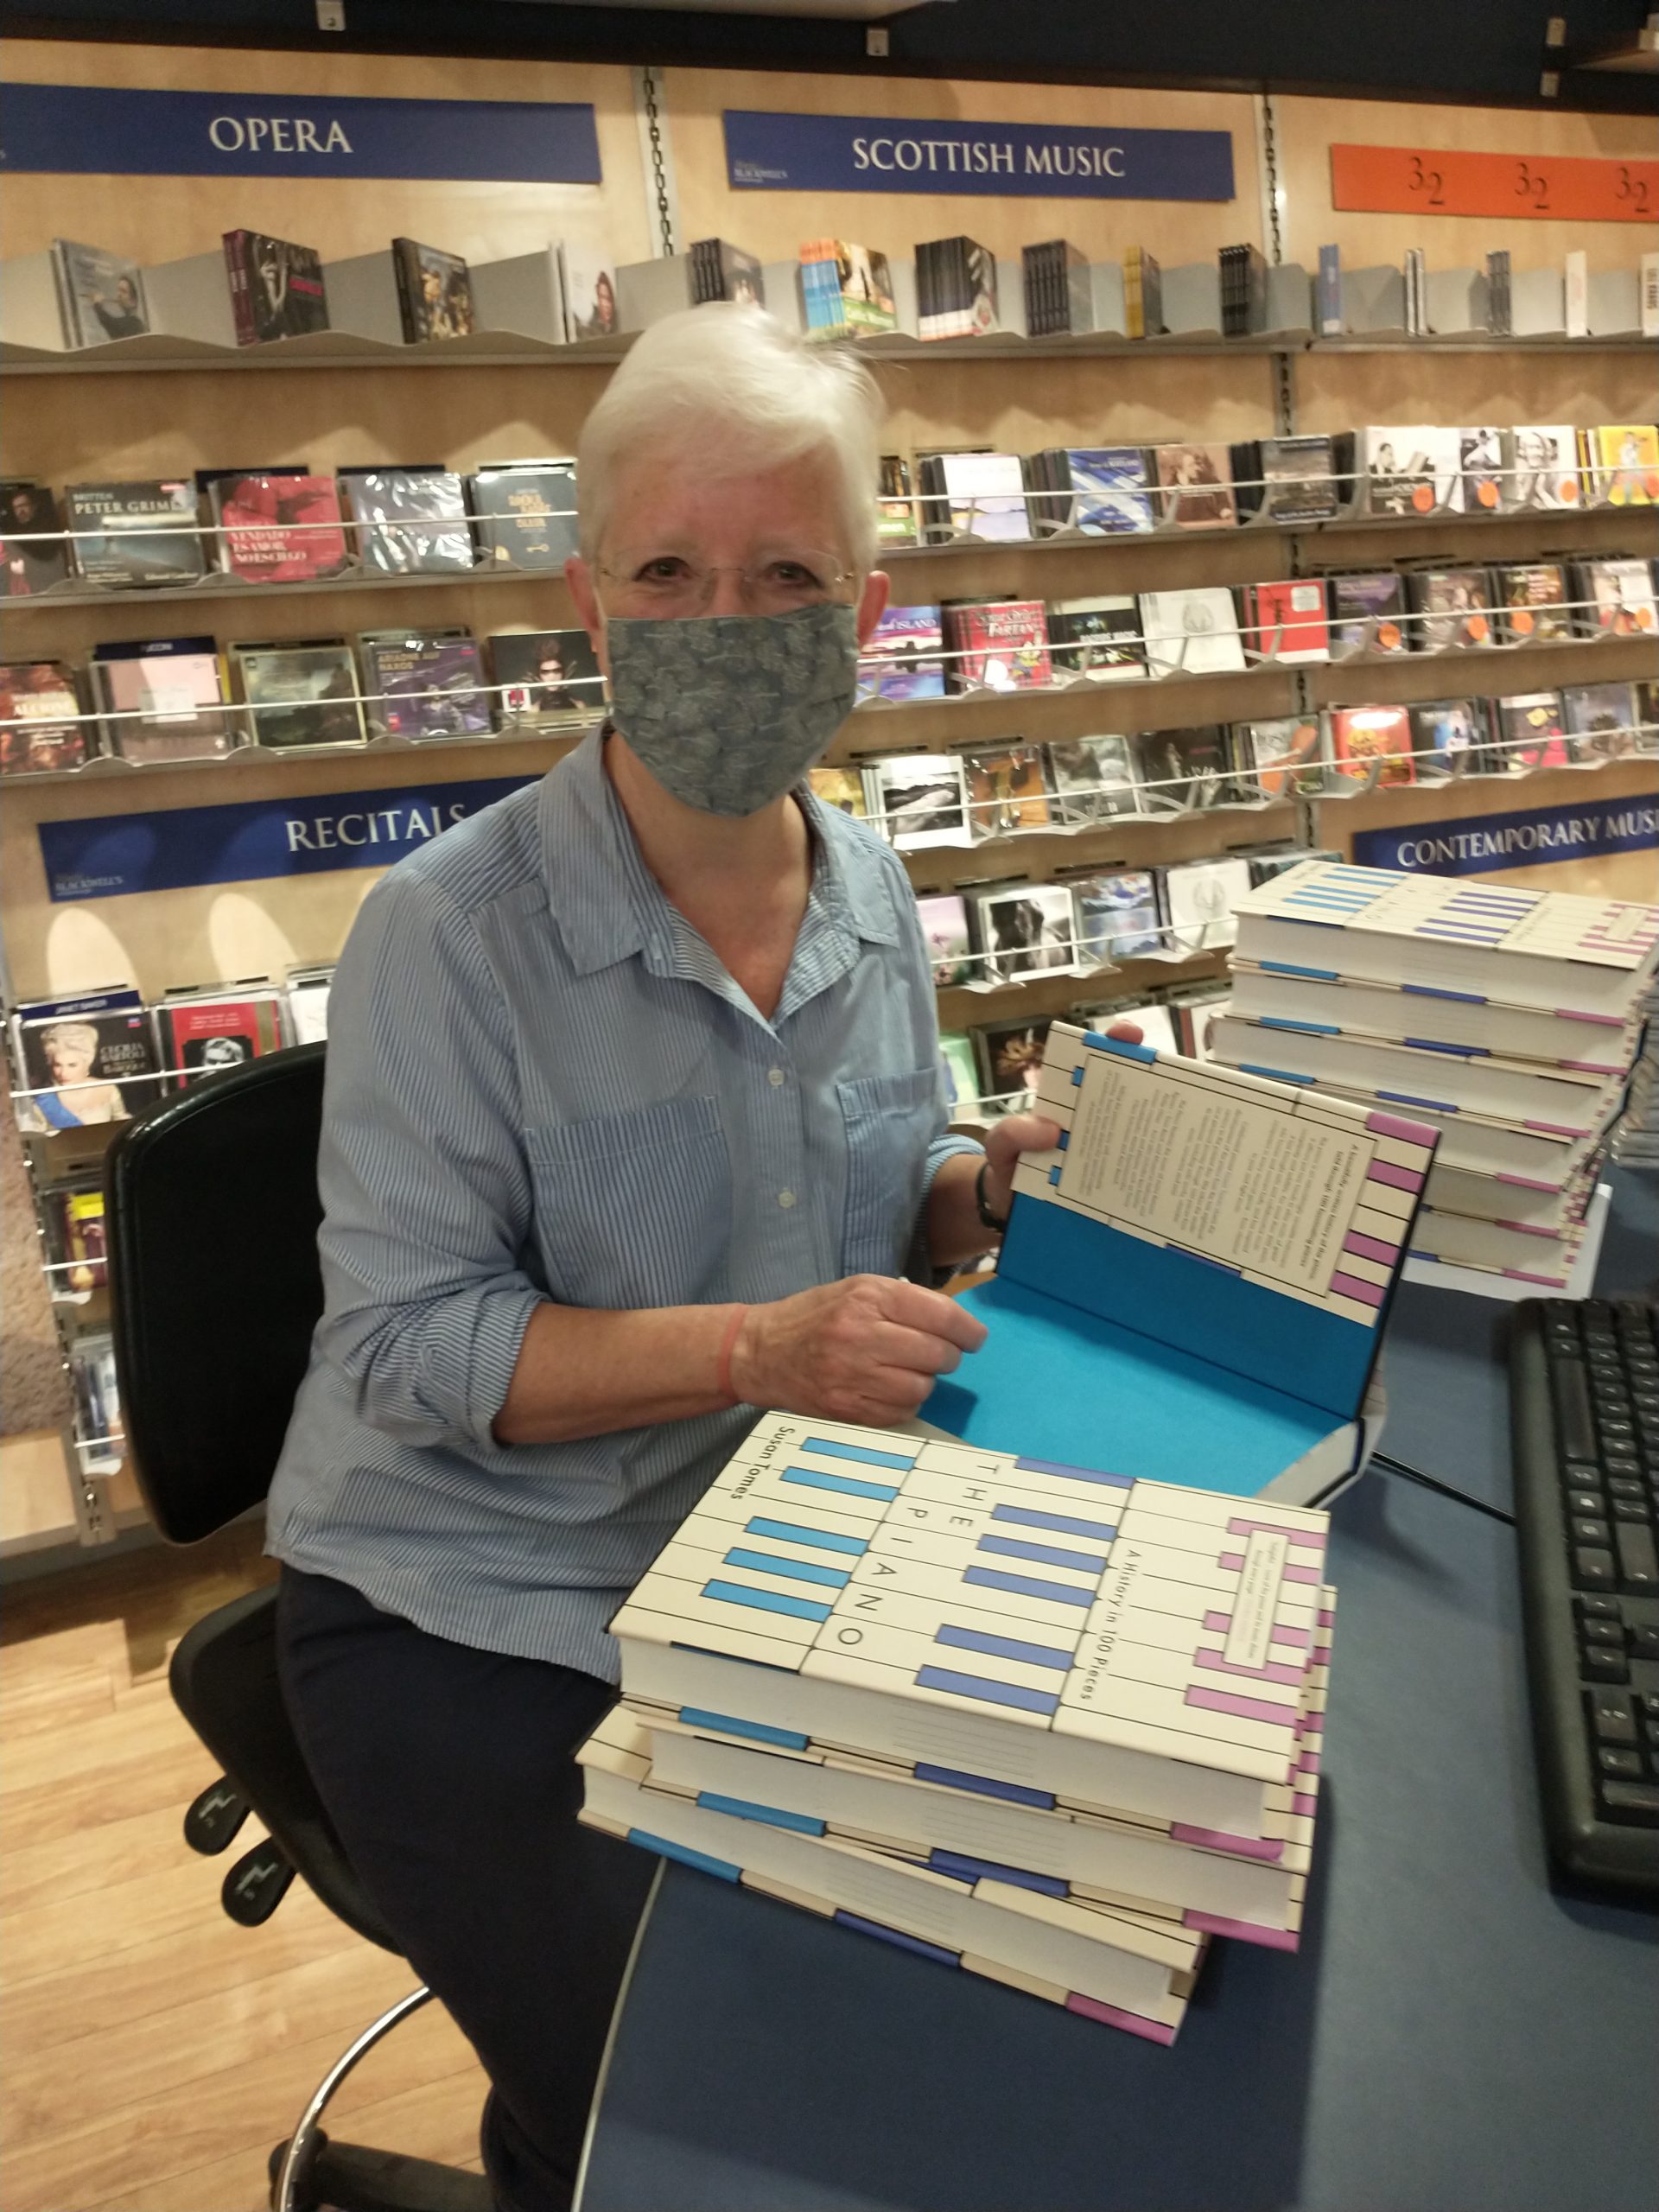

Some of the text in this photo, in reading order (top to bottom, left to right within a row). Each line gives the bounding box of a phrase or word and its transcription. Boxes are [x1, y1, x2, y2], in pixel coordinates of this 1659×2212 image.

[208, 116, 353, 154] OPERA
[852, 137, 1127, 178] SCOTTISH MUSIC
[74, 501, 123, 515] PETER
[1395, 816, 1600, 868] CONTEMPORARY
[730, 1426, 796, 1500] Susan Tomes
[837, 1506, 929, 1646] PIANO
[1108, 1561, 1140, 1607] History
[1105, 1611, 1124, 1623] in
[1096, 1630, 1119, 1652] 100
[1080, 1656, 1109, 1700] Pieces
